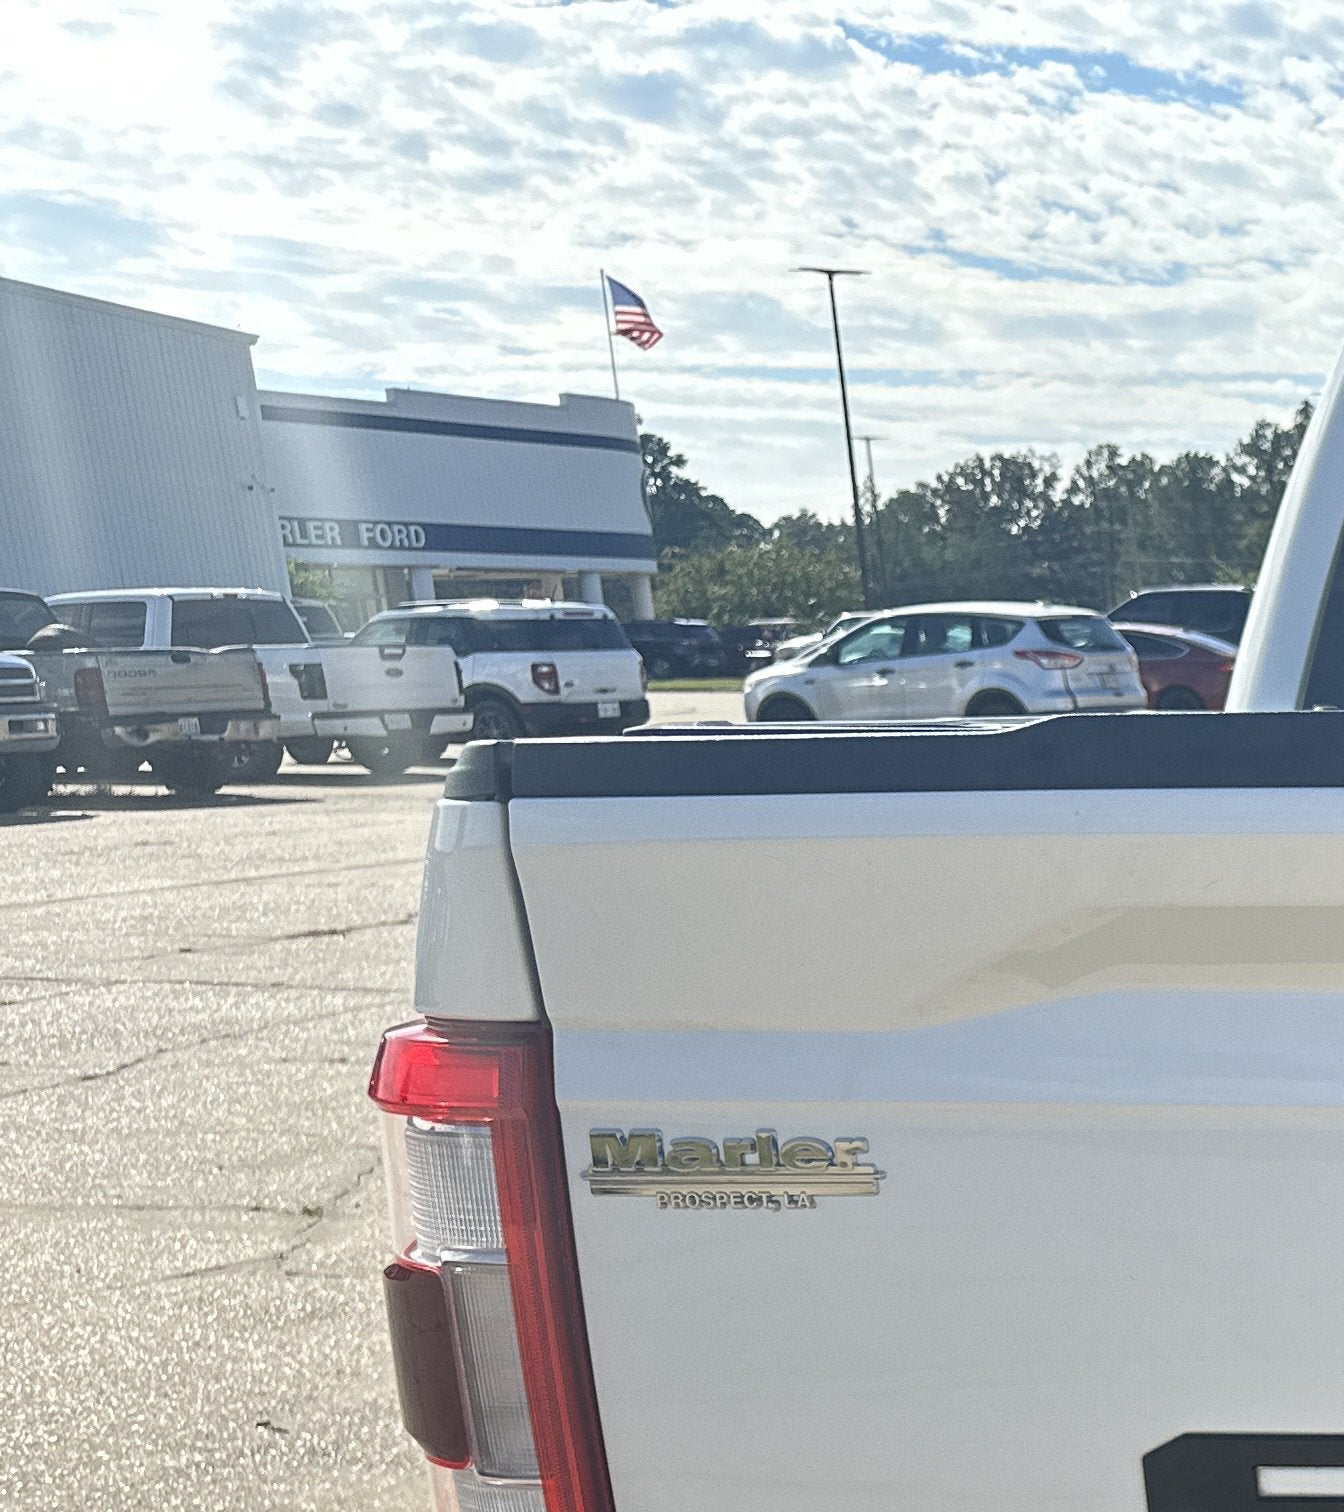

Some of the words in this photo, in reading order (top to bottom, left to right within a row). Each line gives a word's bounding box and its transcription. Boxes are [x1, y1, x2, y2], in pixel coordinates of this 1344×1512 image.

[357, 521, 426, 548] FORD
[589, 1128, 870, 1171] Marler
[655, 1190, 781, 1212] PROSPECT,
[784, 1191, 817, 1209] LA
